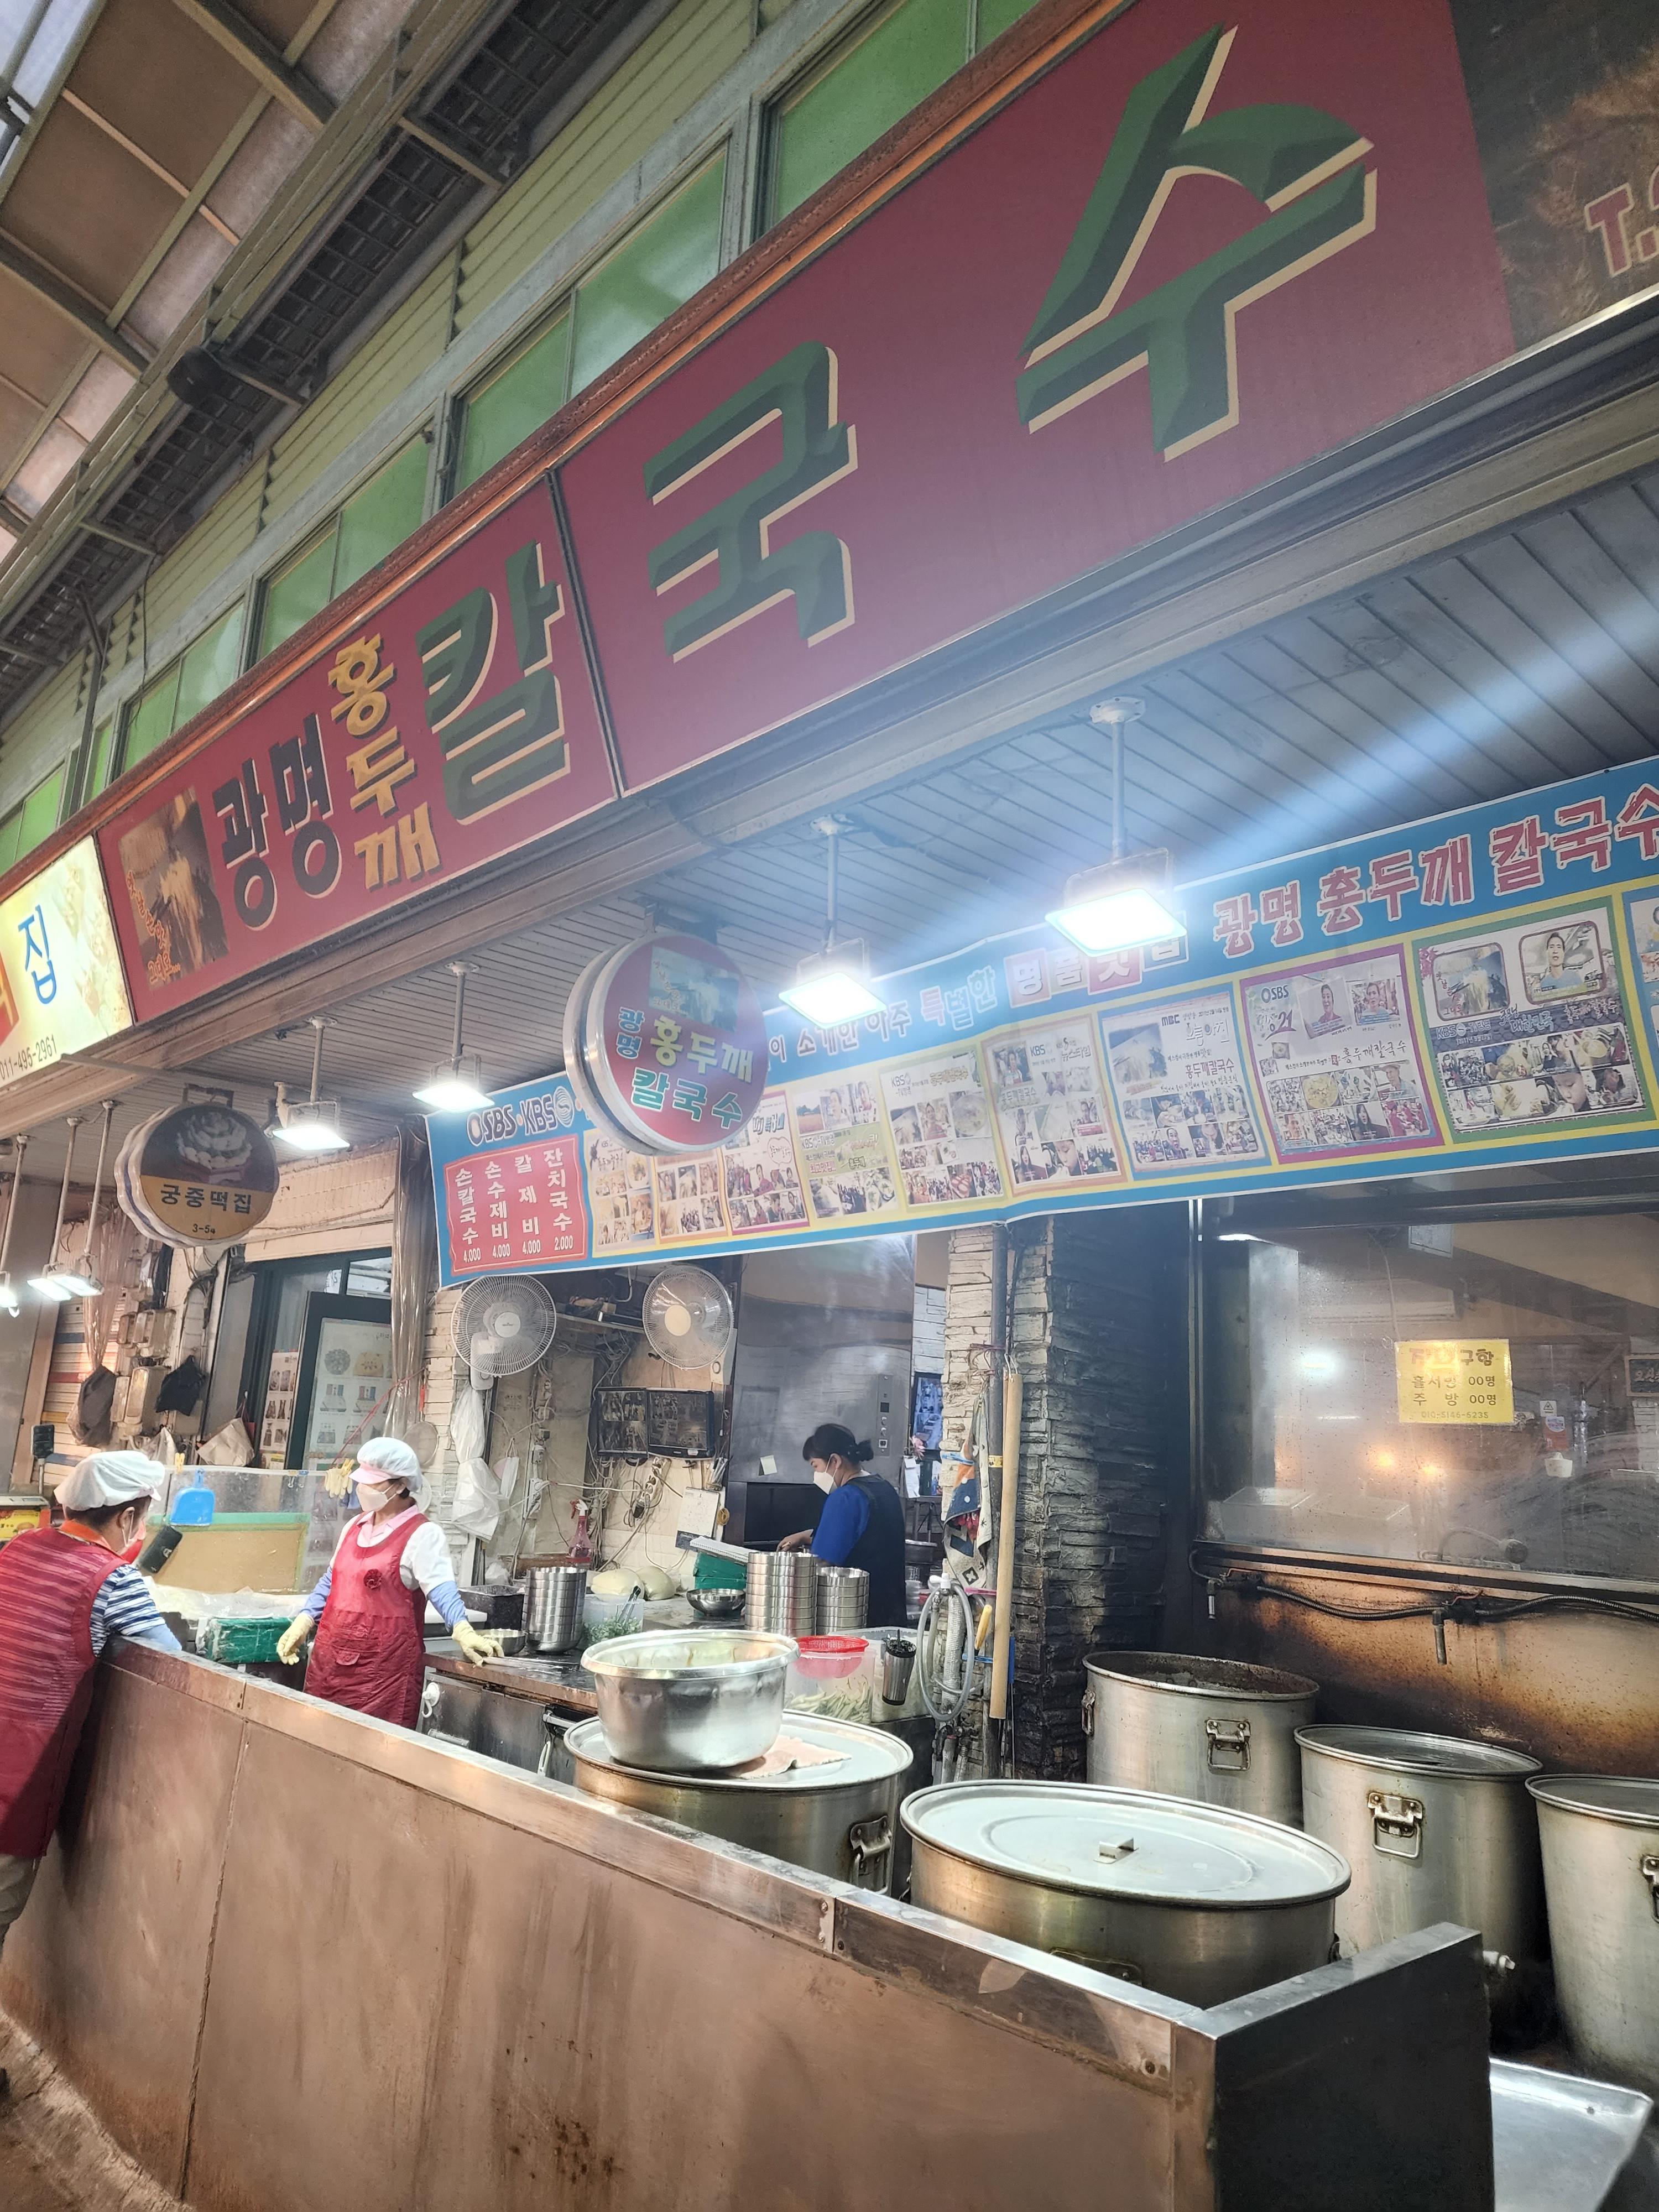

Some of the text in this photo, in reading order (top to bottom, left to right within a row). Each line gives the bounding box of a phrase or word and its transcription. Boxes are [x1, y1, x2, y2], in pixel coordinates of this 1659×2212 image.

[328, 633, 442, 894] 홍두깨
[212, 712, 342, 931] 광명
[864, 1000, 914, 1042] 아주
[920, 966, 997, 1030] 특별한
[1214, 880, 1302, 958] 광명
[1317, 833, 1475, 937] 홍두깨
[1489, 783, 1659, 897] 칼국수
[18, 904, 57, 1004] 집
[1271, 984, 1289, 1000] SBS
[616, 1006, 645, 1060] 광명
[1161, 1014, 1181, 1026] MBC
[1436, 1024, 1456, 1040] KBS
[0, 1033, 58, 1081] 011-495-2961
[650, 1015, 754, 1083] 홍두깨
[1030, 1044, 1046, 1057] KBS
[1185, 1057, 1234, 1079] 홍두깨칼국수
[1342, 1040, 1407, 1065] 홍두깨칼국수
[630, 1067, 744, 1130] 칼국수
[891, 1074, 905, 1088] KBS
[481, 1094, 558, 1144] SBS KBS
[160, 1183, 252, 1214] 궁중떡집
[455, 1167, 479, 1245] 손칼국수
[484, 1161, 509, 1240] 손수제비
[543, 1147, 573, 1232] 잔치국수
[192, 1223, 216, 1234] 3-54
